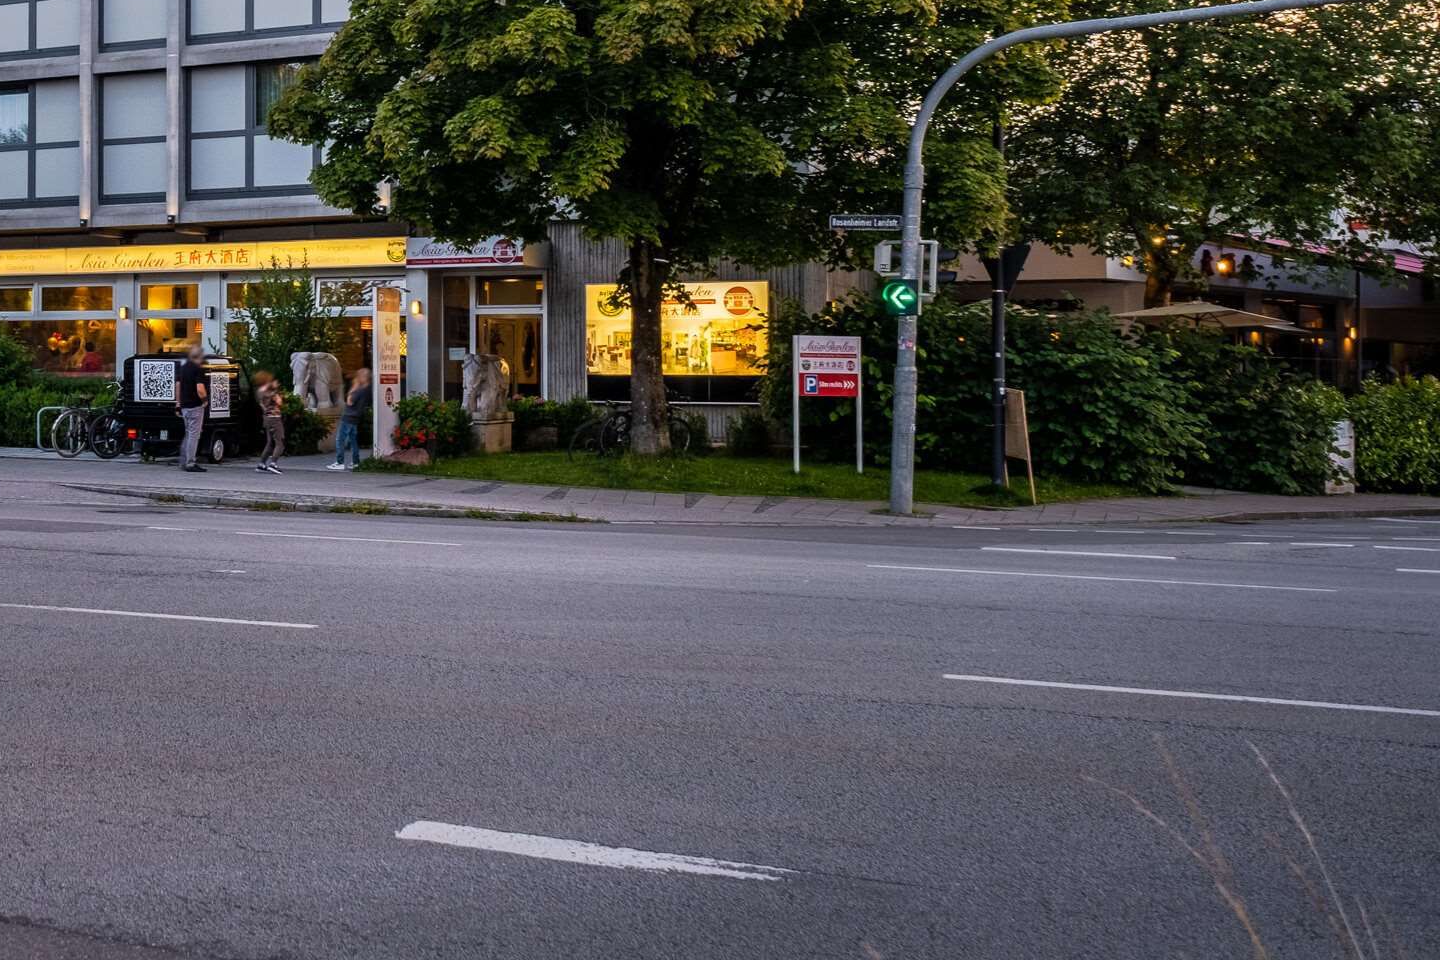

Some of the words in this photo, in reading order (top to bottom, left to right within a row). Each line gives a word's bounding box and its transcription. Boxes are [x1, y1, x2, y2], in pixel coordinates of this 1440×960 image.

[70, 253, 107, 269] Asia
[111, 250, 165, 268] Garden
[173, 248, 249, 266] 王府大酒店
[806, 377, 816, 391] P
